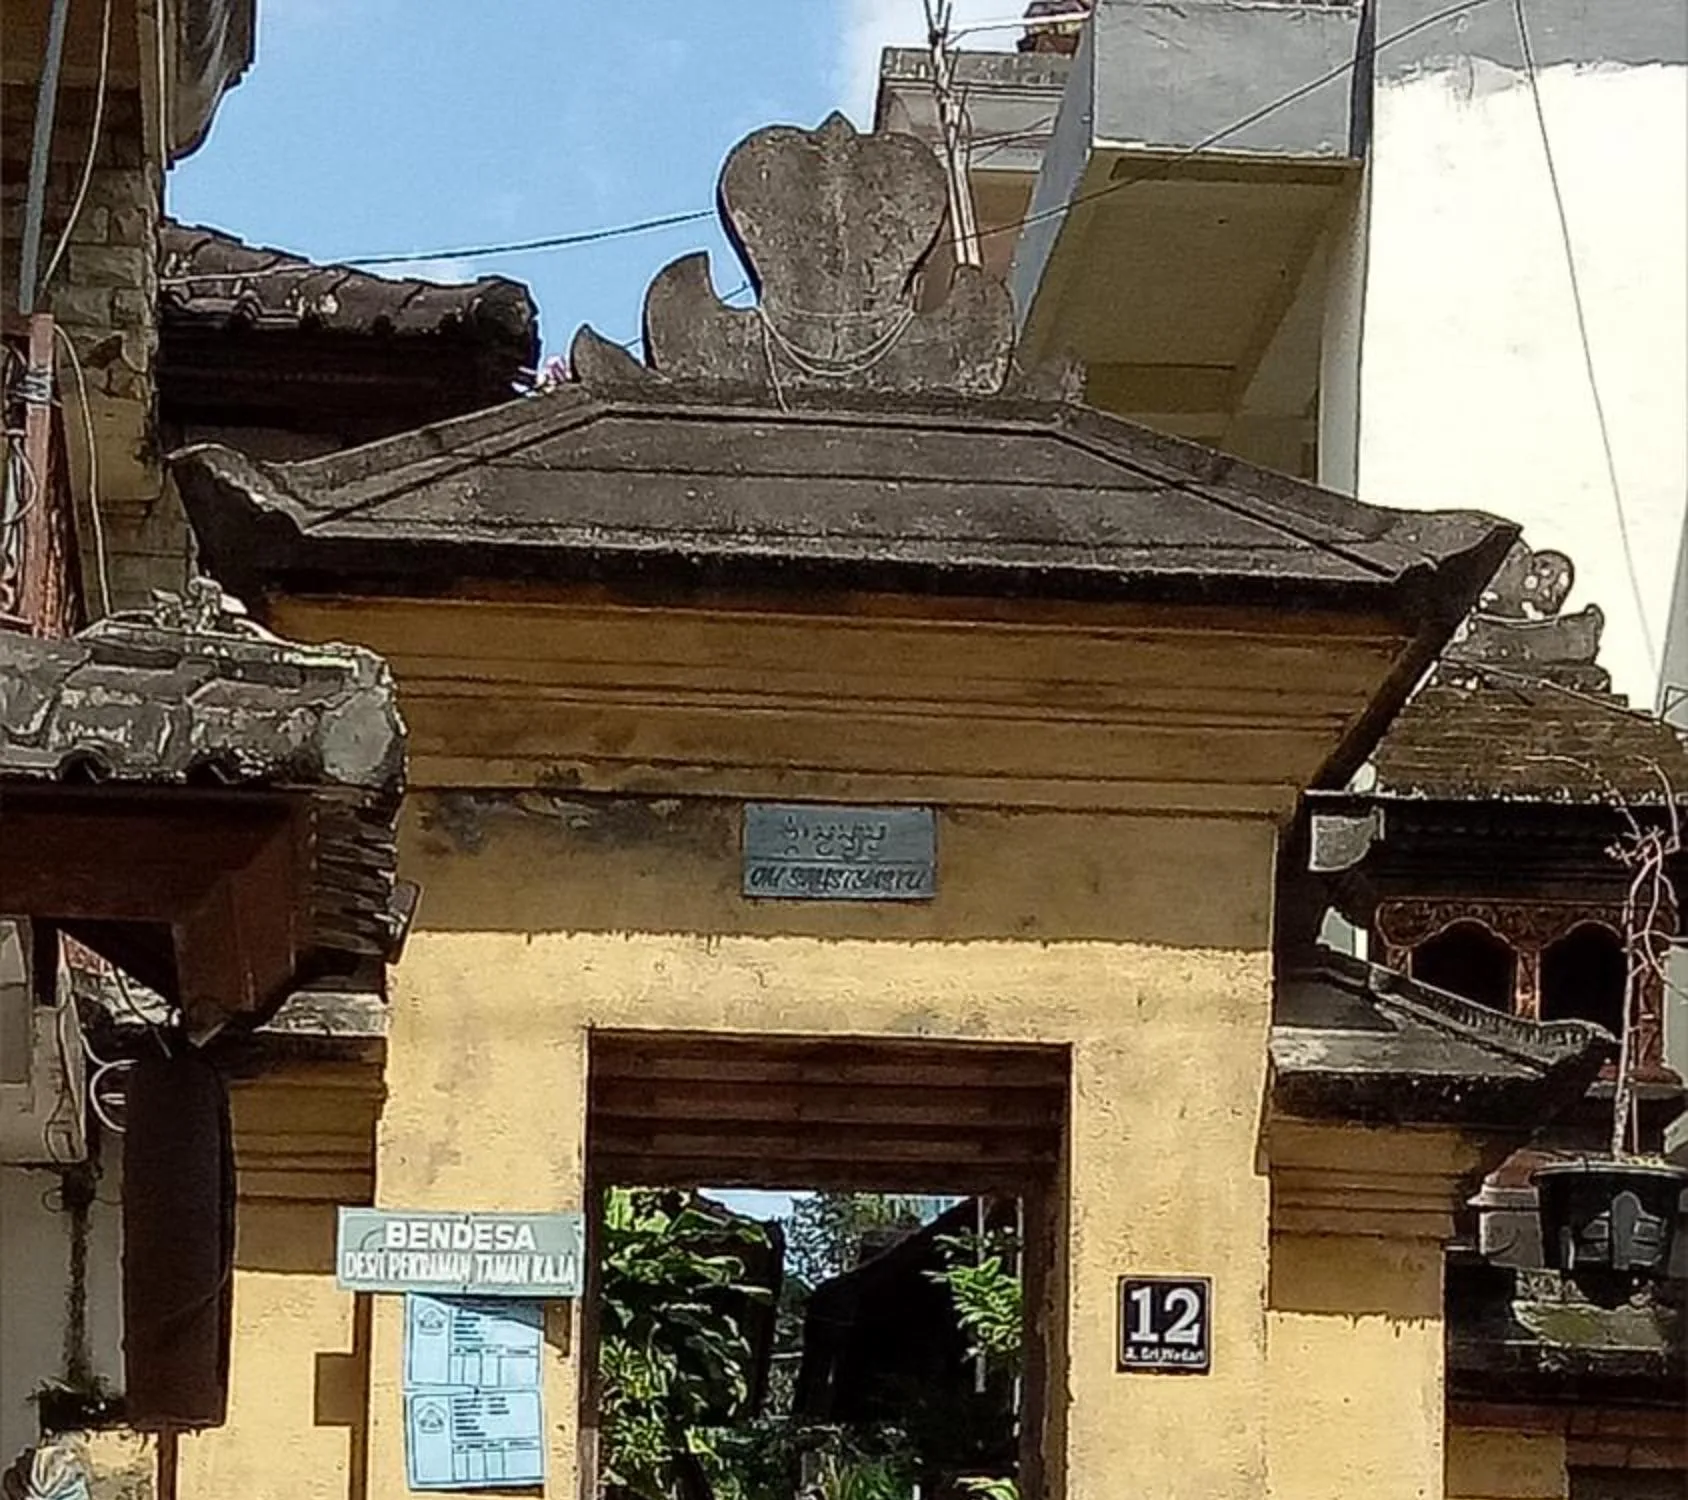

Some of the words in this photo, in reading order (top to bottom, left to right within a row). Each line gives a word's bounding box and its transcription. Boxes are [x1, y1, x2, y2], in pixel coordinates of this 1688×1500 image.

[385, 1220, 537, 1251] BENDESA
[532, 1255, 576, 1285] KAJA
[1130, 1286, 1201, 1346] 12
